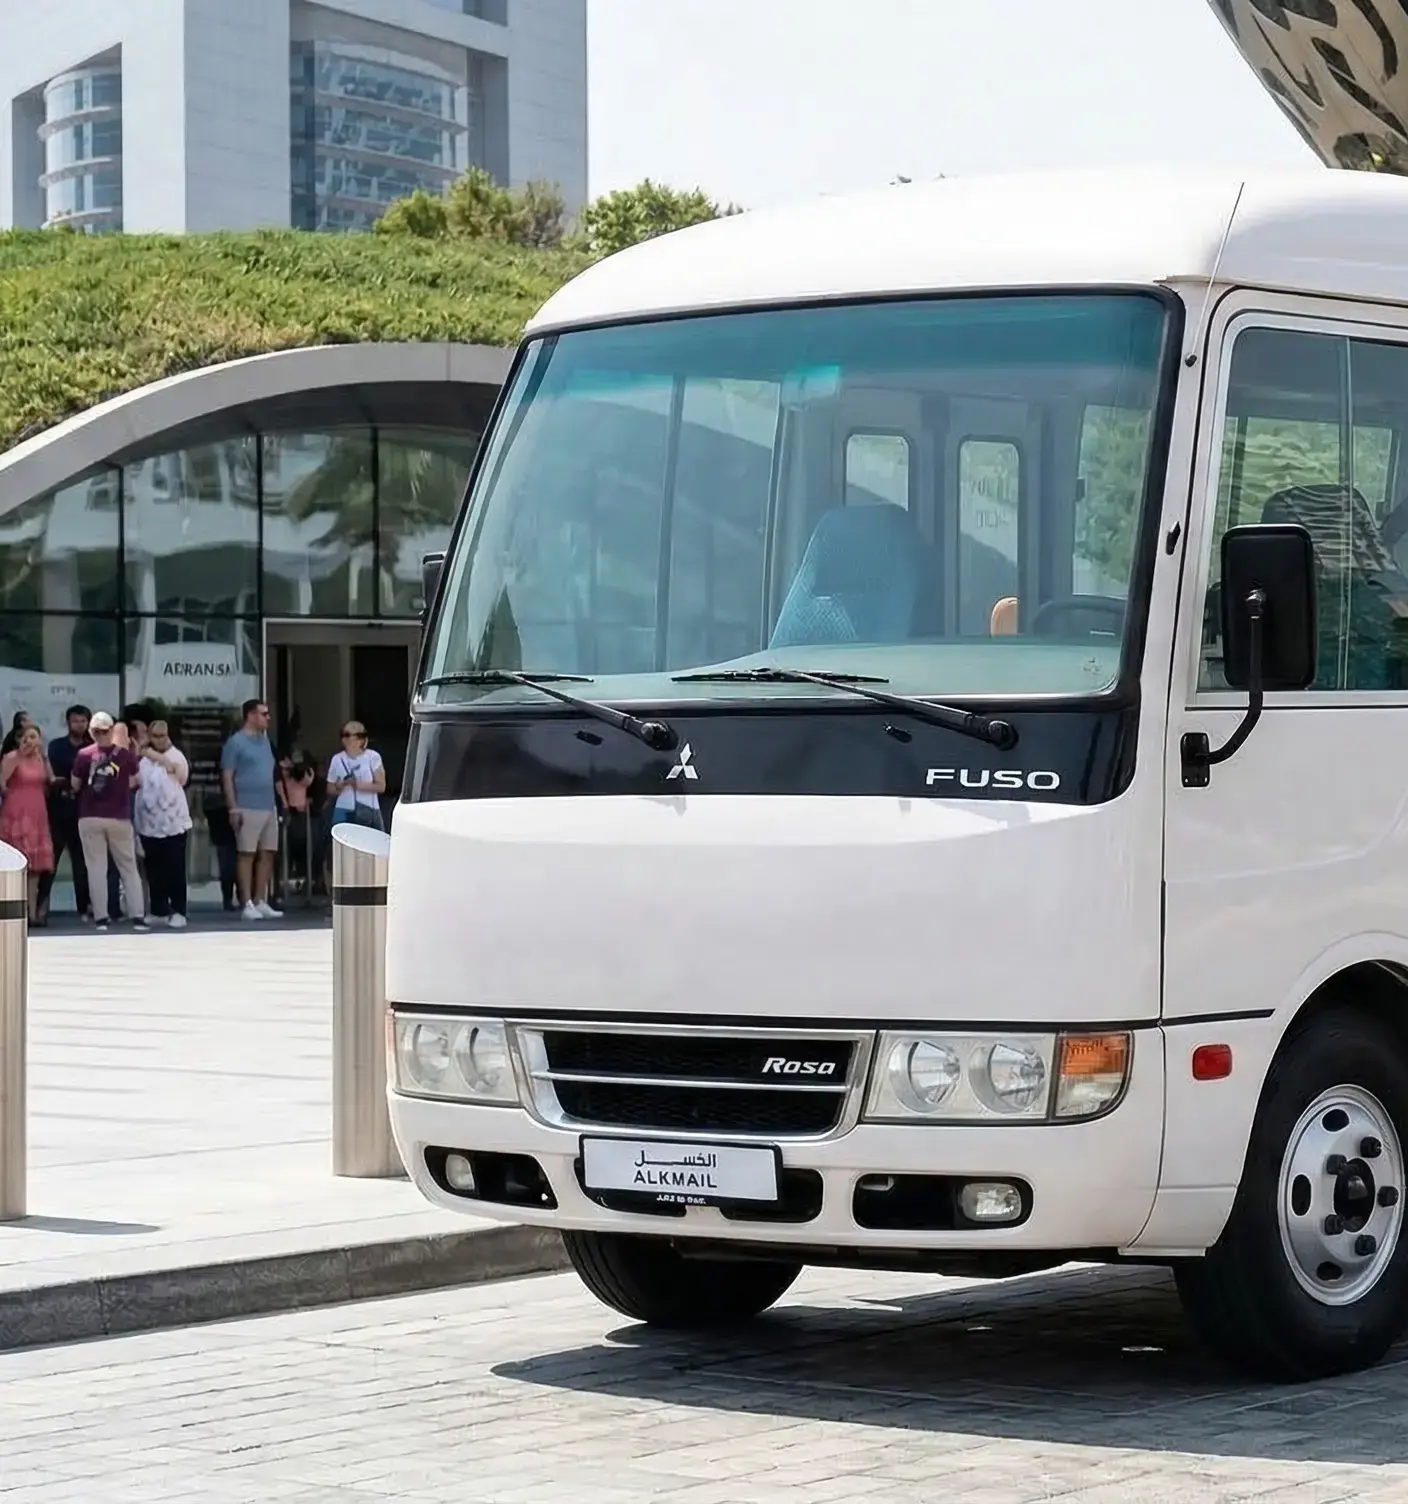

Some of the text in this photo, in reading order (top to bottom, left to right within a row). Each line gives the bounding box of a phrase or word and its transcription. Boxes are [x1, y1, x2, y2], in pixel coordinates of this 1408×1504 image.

[926, 768, 1061, 790] FUSO
[761, 1057, 836, 1075] Rosa
[633, 1169, 718, 1189] ALKMAIL
